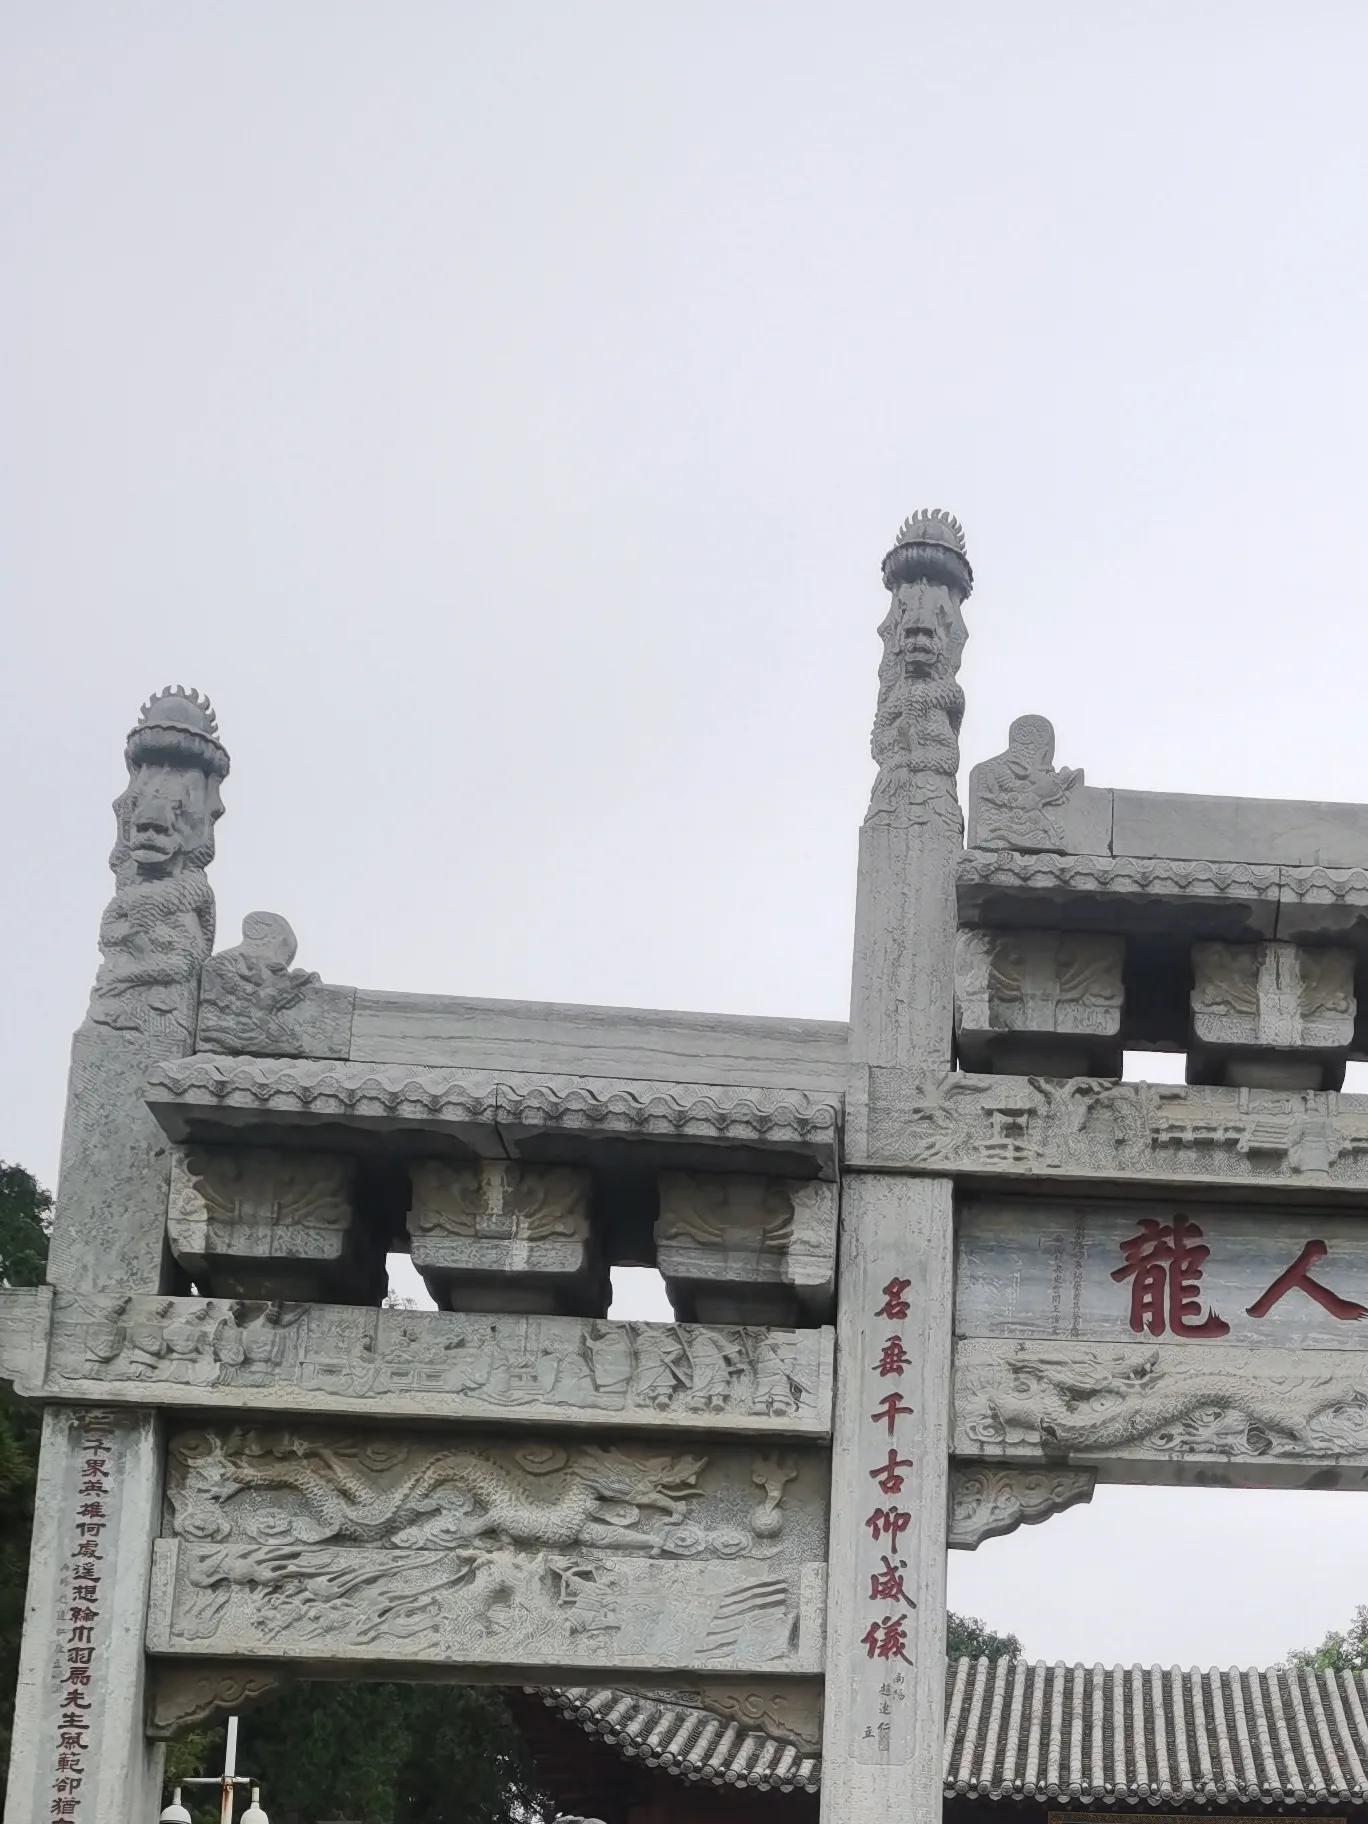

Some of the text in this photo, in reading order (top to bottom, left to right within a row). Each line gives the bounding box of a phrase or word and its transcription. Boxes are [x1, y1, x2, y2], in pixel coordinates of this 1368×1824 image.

[859, 1276, 918, 1667] 名垂千古仰威儀
